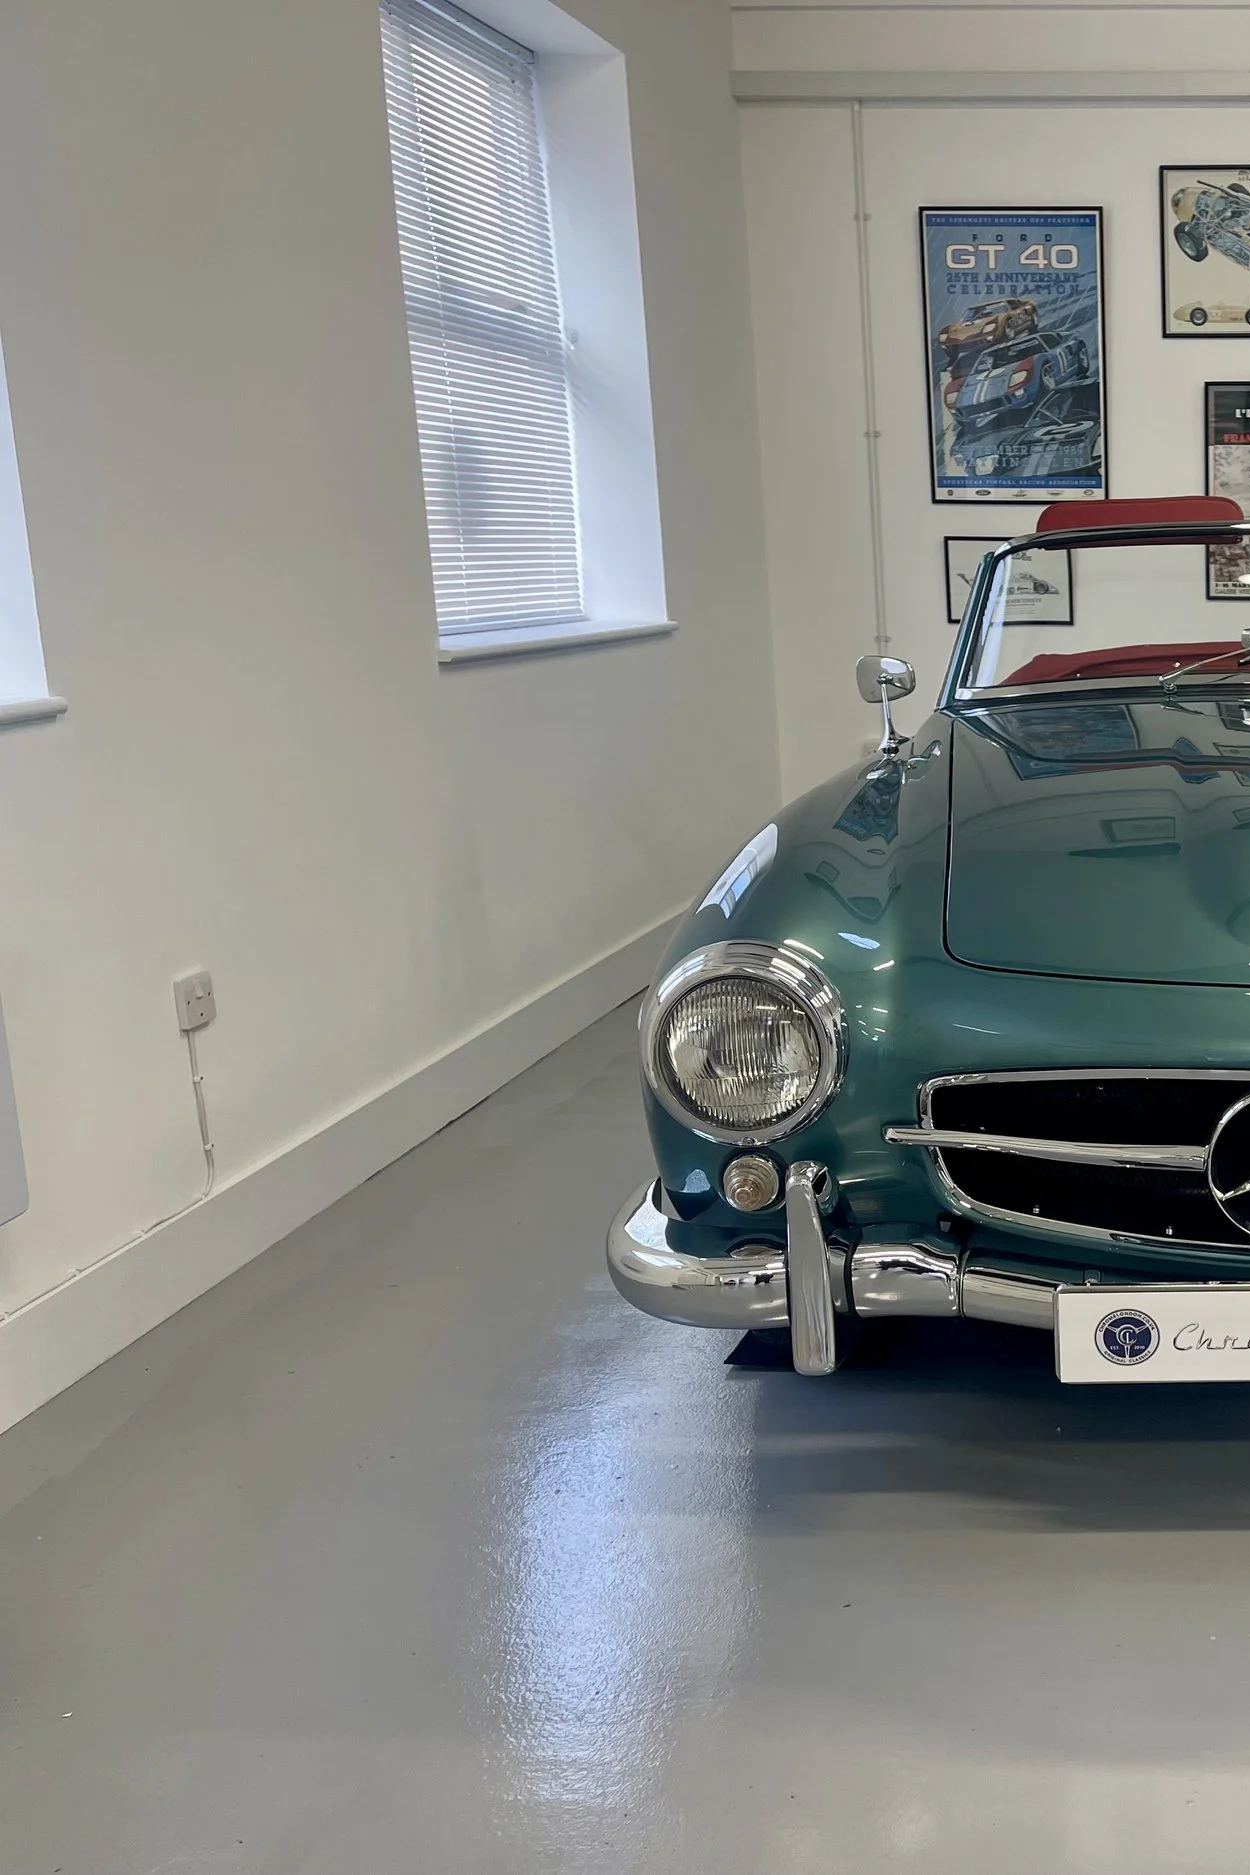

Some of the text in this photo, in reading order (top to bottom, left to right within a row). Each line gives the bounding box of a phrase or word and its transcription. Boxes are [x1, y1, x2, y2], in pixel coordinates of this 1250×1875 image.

[972, 233, 1053, 242] FORD
[946, 244, 1079, 269] GT 40
[946, 272, 1079, 283] 25TH ANNIVERSARY
[946, 284, 1080, 295] CELEBRATION
